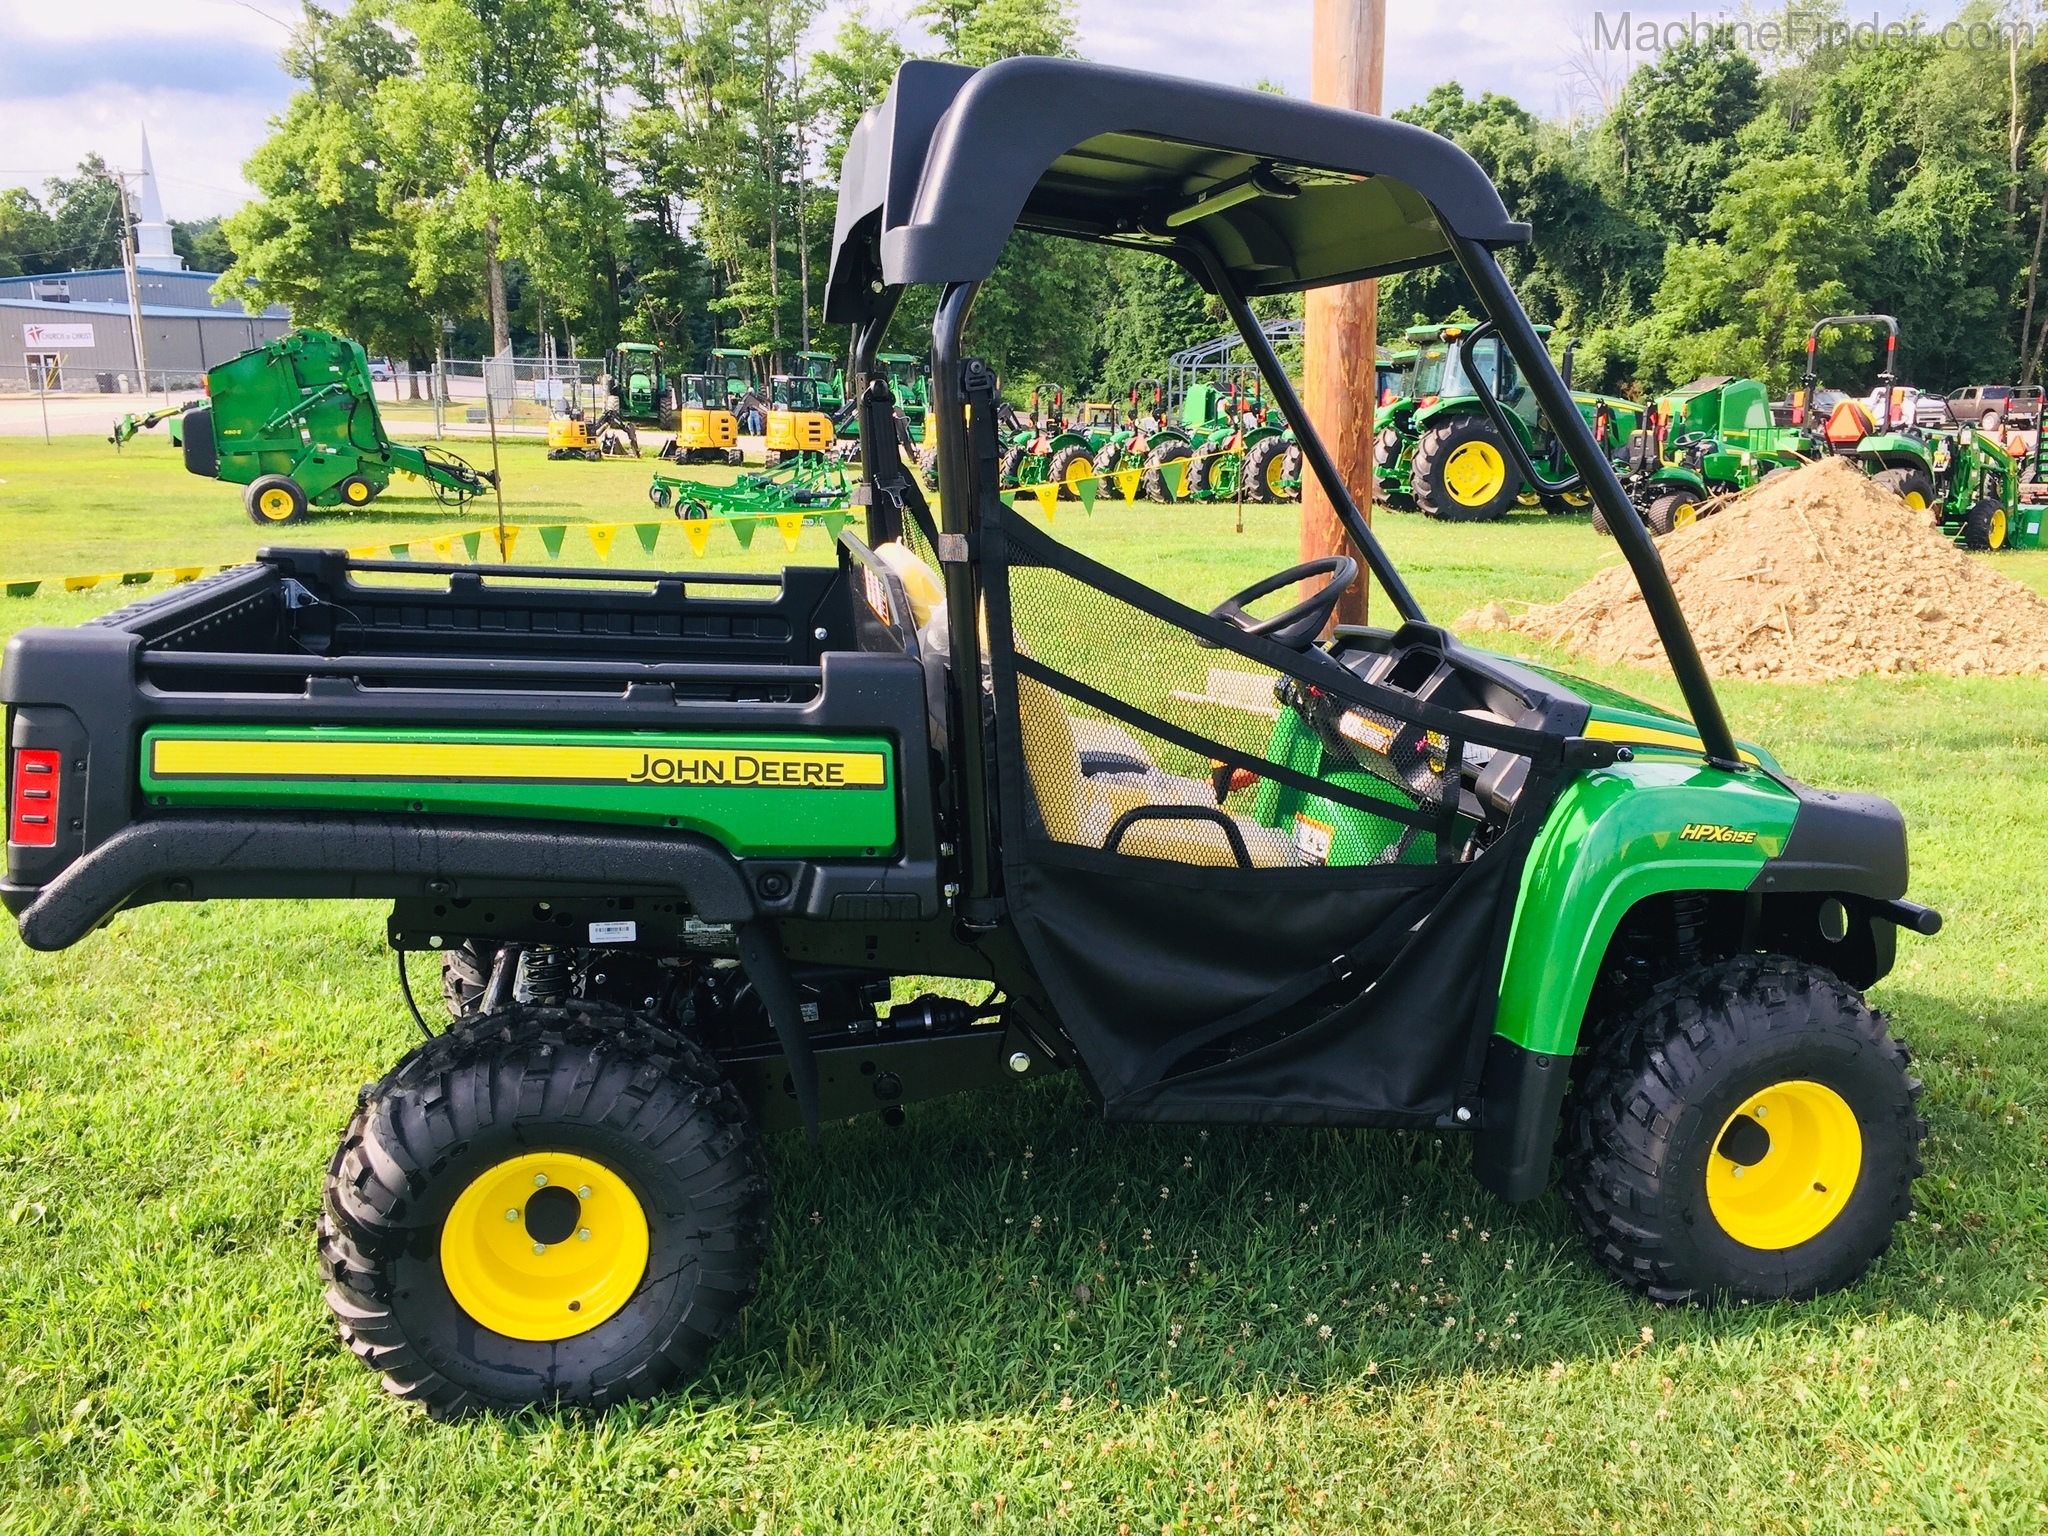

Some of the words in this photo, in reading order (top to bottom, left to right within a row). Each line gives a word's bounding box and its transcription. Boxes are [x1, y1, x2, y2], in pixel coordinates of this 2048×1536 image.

[41, 332, 65, 340] CHURCH
[71, 332, 92, 340] CHRIST
[630, 754, 725, 781] JOHN
[734, 756, 845, 783] DEERE
[1680, 823, 1757, 843] HPX615E
